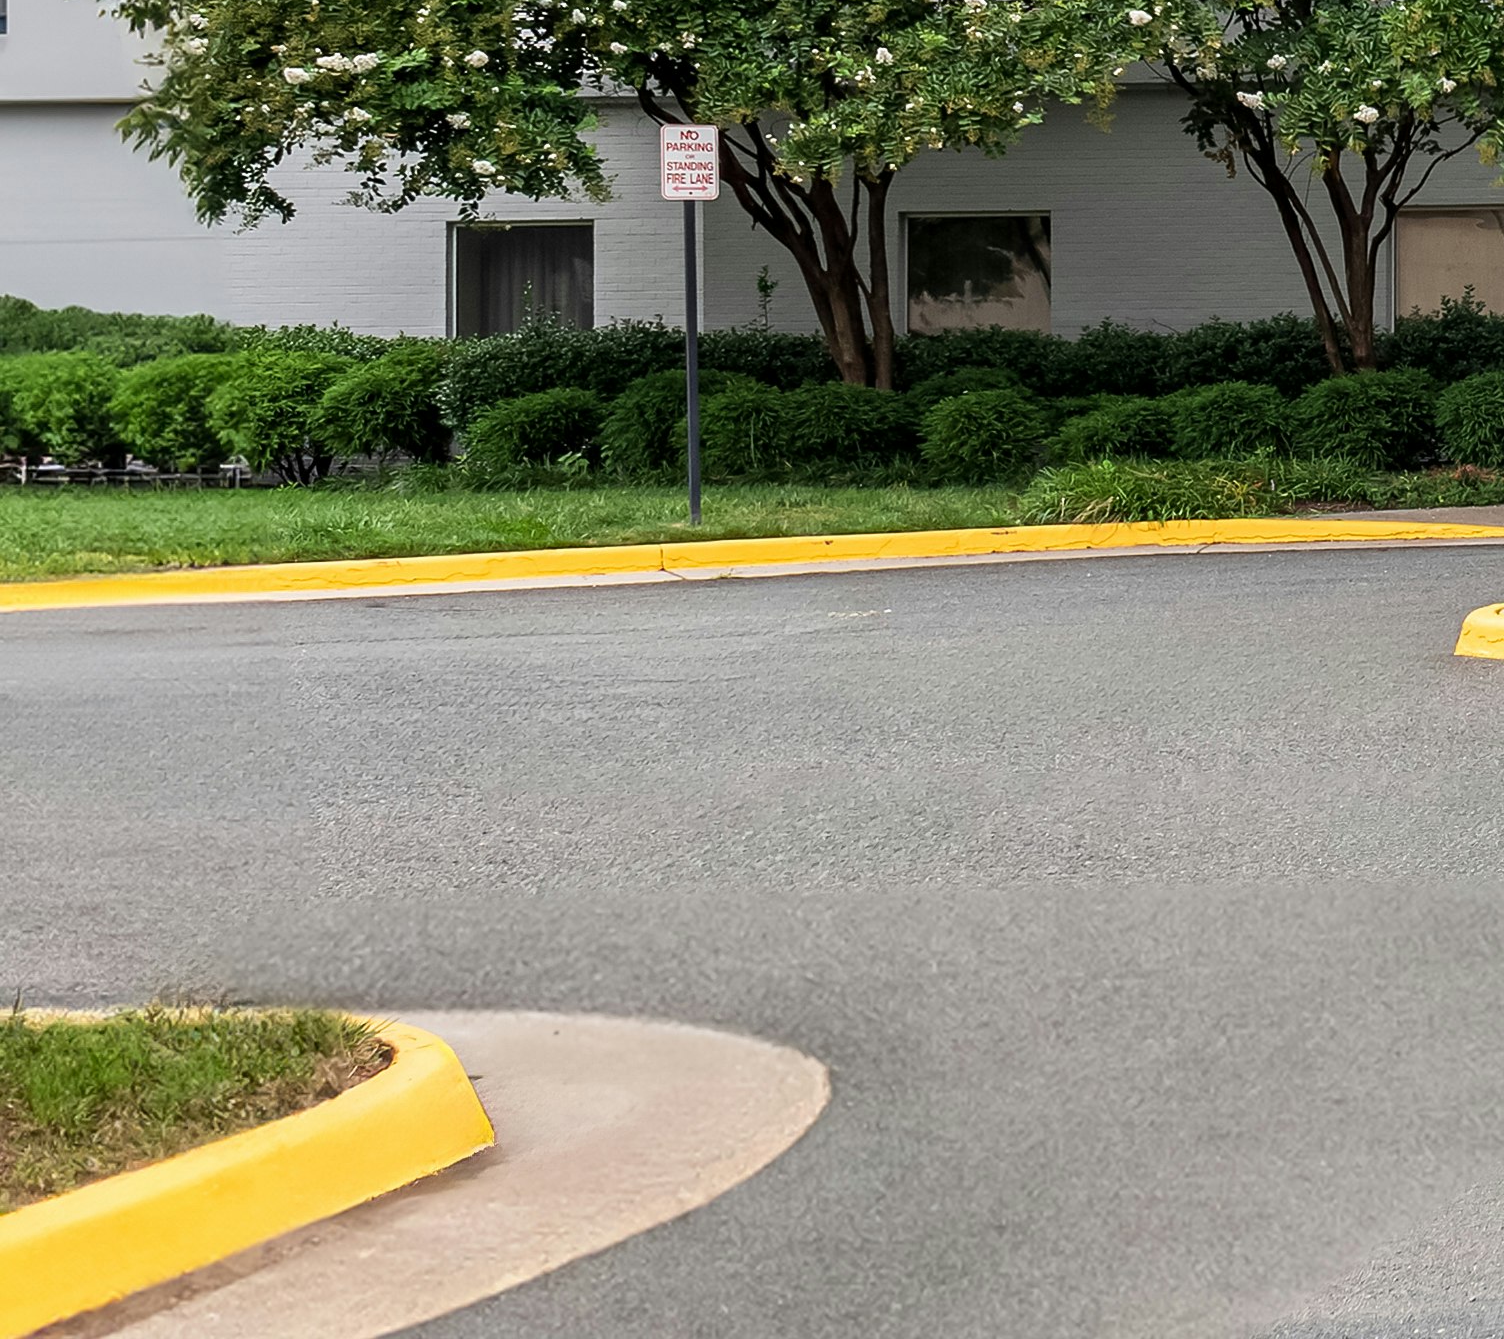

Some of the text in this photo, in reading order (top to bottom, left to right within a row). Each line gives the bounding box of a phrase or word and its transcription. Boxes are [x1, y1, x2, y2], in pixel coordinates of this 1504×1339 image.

[680, 130, 699, 140] NO
[666, 142, 713, 152] PARKING
[666, 161, 714, 171] STANDING
[666, 173, 713, 184] FIRE LANE
